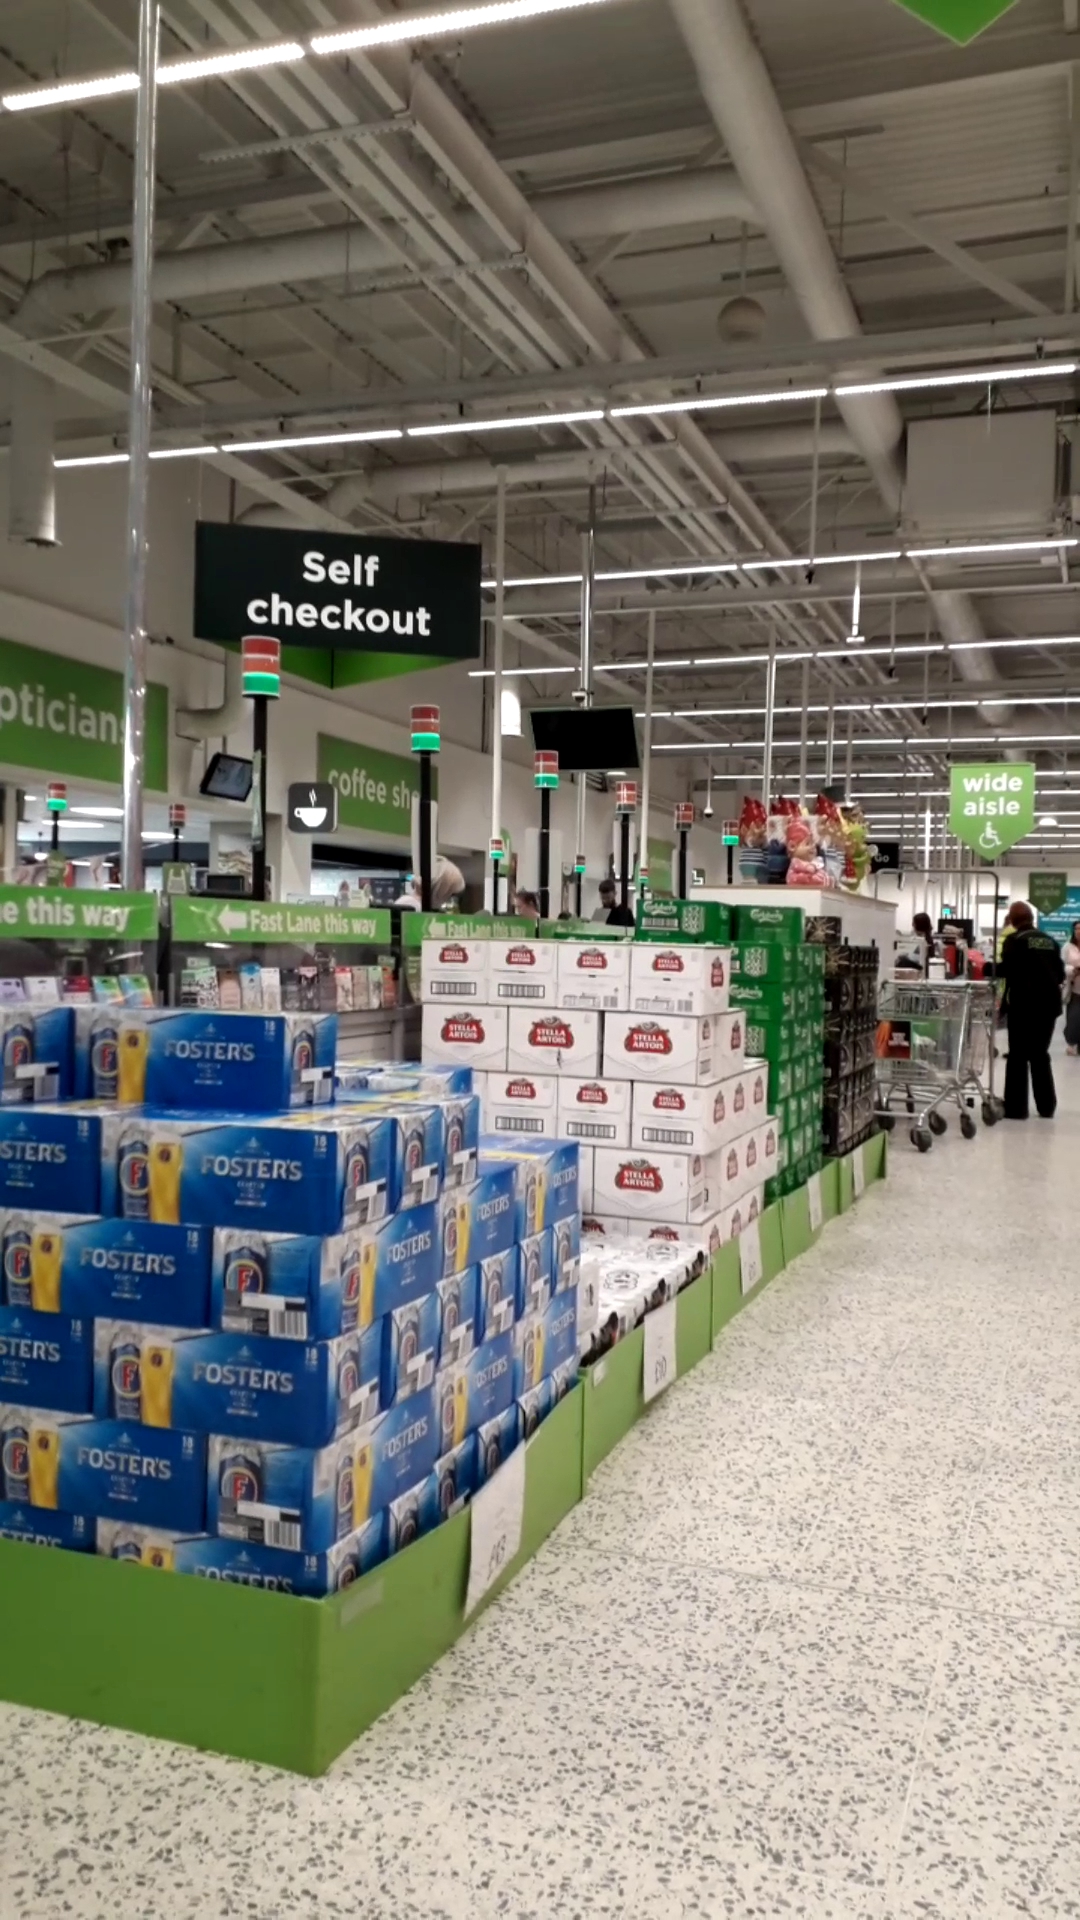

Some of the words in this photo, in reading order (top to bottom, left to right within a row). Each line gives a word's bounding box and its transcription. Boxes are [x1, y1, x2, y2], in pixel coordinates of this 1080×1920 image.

[302, 550, 380, 587] Self
[246, 592, 431, 637] checkout
[328, 768, 387, 804] coffee
[963, 773, 1024, 792] wide
[963, 797, 1021, 816] aisle
[26, 896, 75, 926] this
[82, 904, 131, 932] way
[643, 901, 678, 915] Carlsberg
[751, 908, 783, 923] Carlsberg
[251, 909, 283, 933] Fast
[286, 911, 322, 934] Lane
[324, 912, 348, 934] this
[352, 917, 377, 938] way
[264, 1020, 276, 1031] 18
[449, 1024, 477, 1032] STELLA
[536, 1027, 566, 1036] STELLA
[448, 1031, 478, 1040] ARTOIS
[536, 1035, 566, 1045] ARTOIS
[633, 1033, 664, 1043] STELLA
[164, 1040, 256, 1062] FOSTER'S
[633, 1041, 664, 1050] ARTOIS
[76, 1119, 89, 1132] 18
[314, 1135, 327, 1147] 18
[201, 1155, 303, 1181] FOSTER'S
[624, 1171, 654, 1180] STELLA
[623, 1178, 654, 1188] ARTOIS
[187, 1230, 199, 1242] 18
[80, 1248, 176, 1276] FOSTER'S
[71, 1319, 82, 1331] 18
[305, 1347, 318, 1360] 18
[193, 1362, 294, 1393] FOSTER'S
[182, 1435, 194, 1448] 18
[77, 1448, 172, 1480] FOSTER'S
[73, 1515, 85, 1527] 18
[304, 1555, 318, 1567] 18
